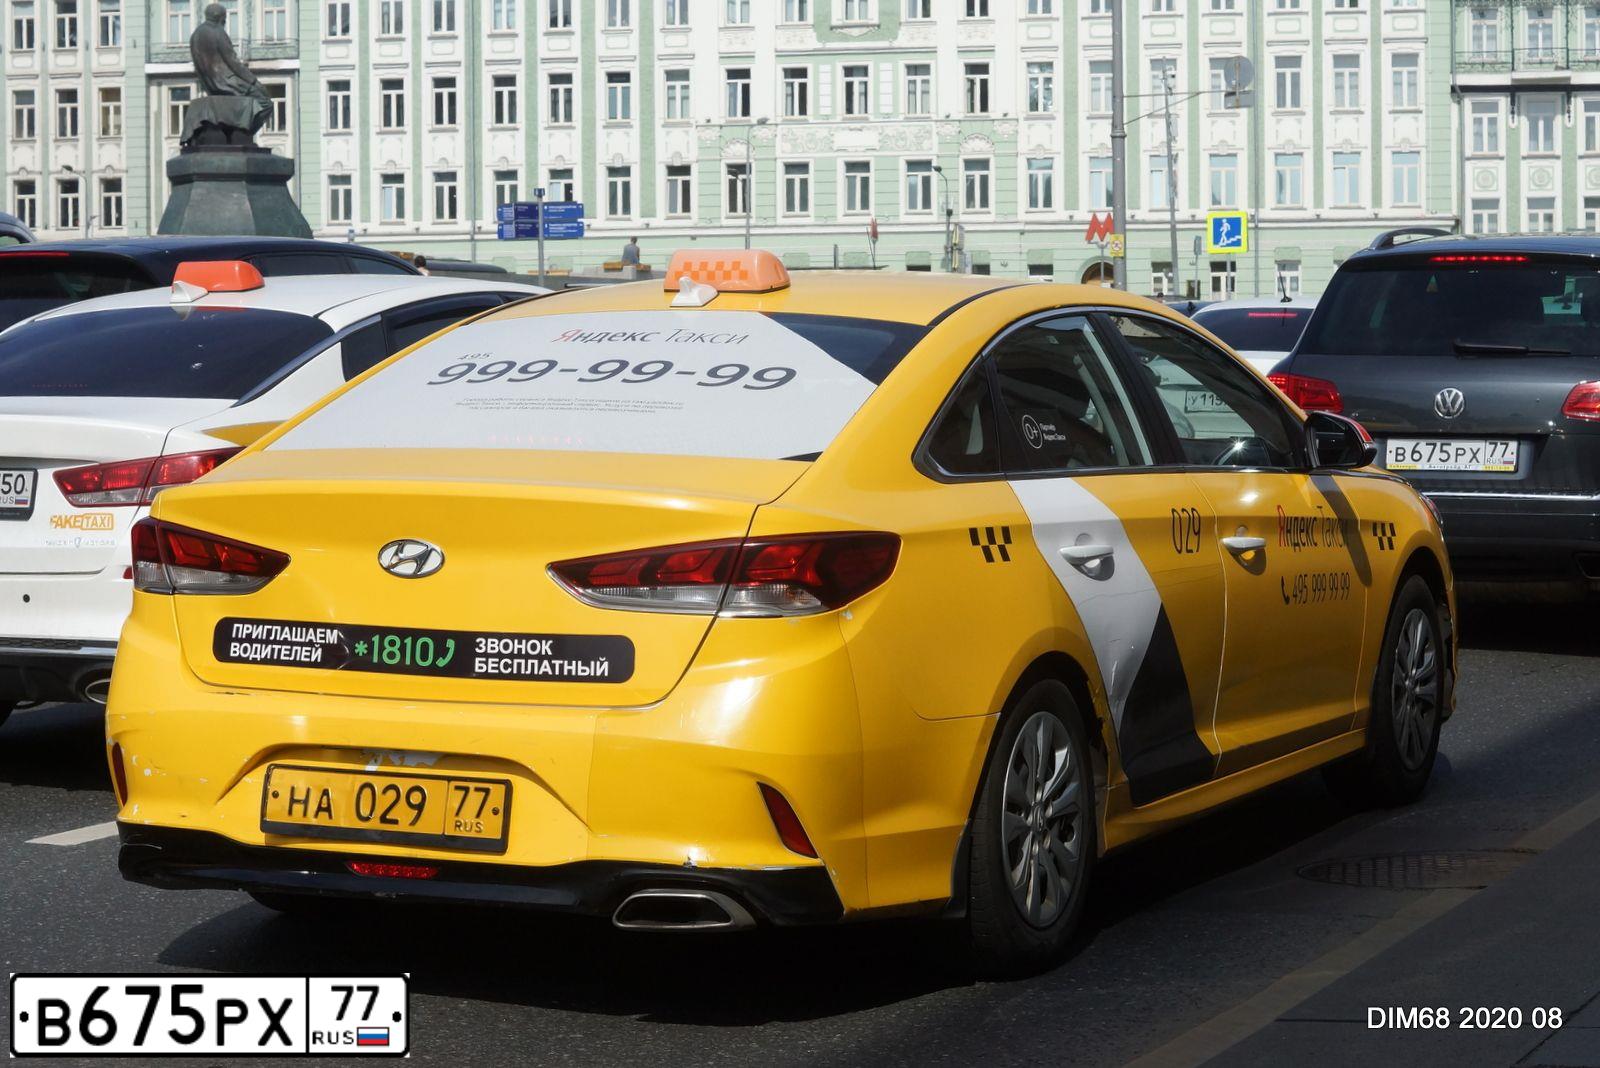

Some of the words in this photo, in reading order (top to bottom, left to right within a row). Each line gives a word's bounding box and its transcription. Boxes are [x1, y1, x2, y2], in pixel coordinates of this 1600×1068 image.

[551, 328, 661, 344] Яндекс
[666, 328, 750, 345] Такси
[457, 352, 493, 360] 495
[427, 359, 797, 391] 999-99-99
[1395, 442, 1480, 463] В675РХ
[1488, 441, 1510, 458] 77
[0, 473, 26, 495] 50
[0, 496, 14, 504] US
[1171, 507, 1201, 554] 029
[1276, 504, 1318, 552] Яндекс
[1292, 573, 1309, 604] 495
[1311, 573, 1327, 602] 999
[1328, 572, 1339, 601] 99
[1340, 572, 1351, 601] 99
[232, 623, 338, 644] ПРИГЛАШАЕМ
[229, 642, 323, 663] ВОДИТЕЛЕЙ
[475, 637, 554, 656] ЗВОНОК
[474, 657, 609, 677] БЕСПЛАТНЫЙ
[354, 782, 428, 827] 029
[453, 785, 492, 819] 77
[453, 818, 484, 834] RUS
